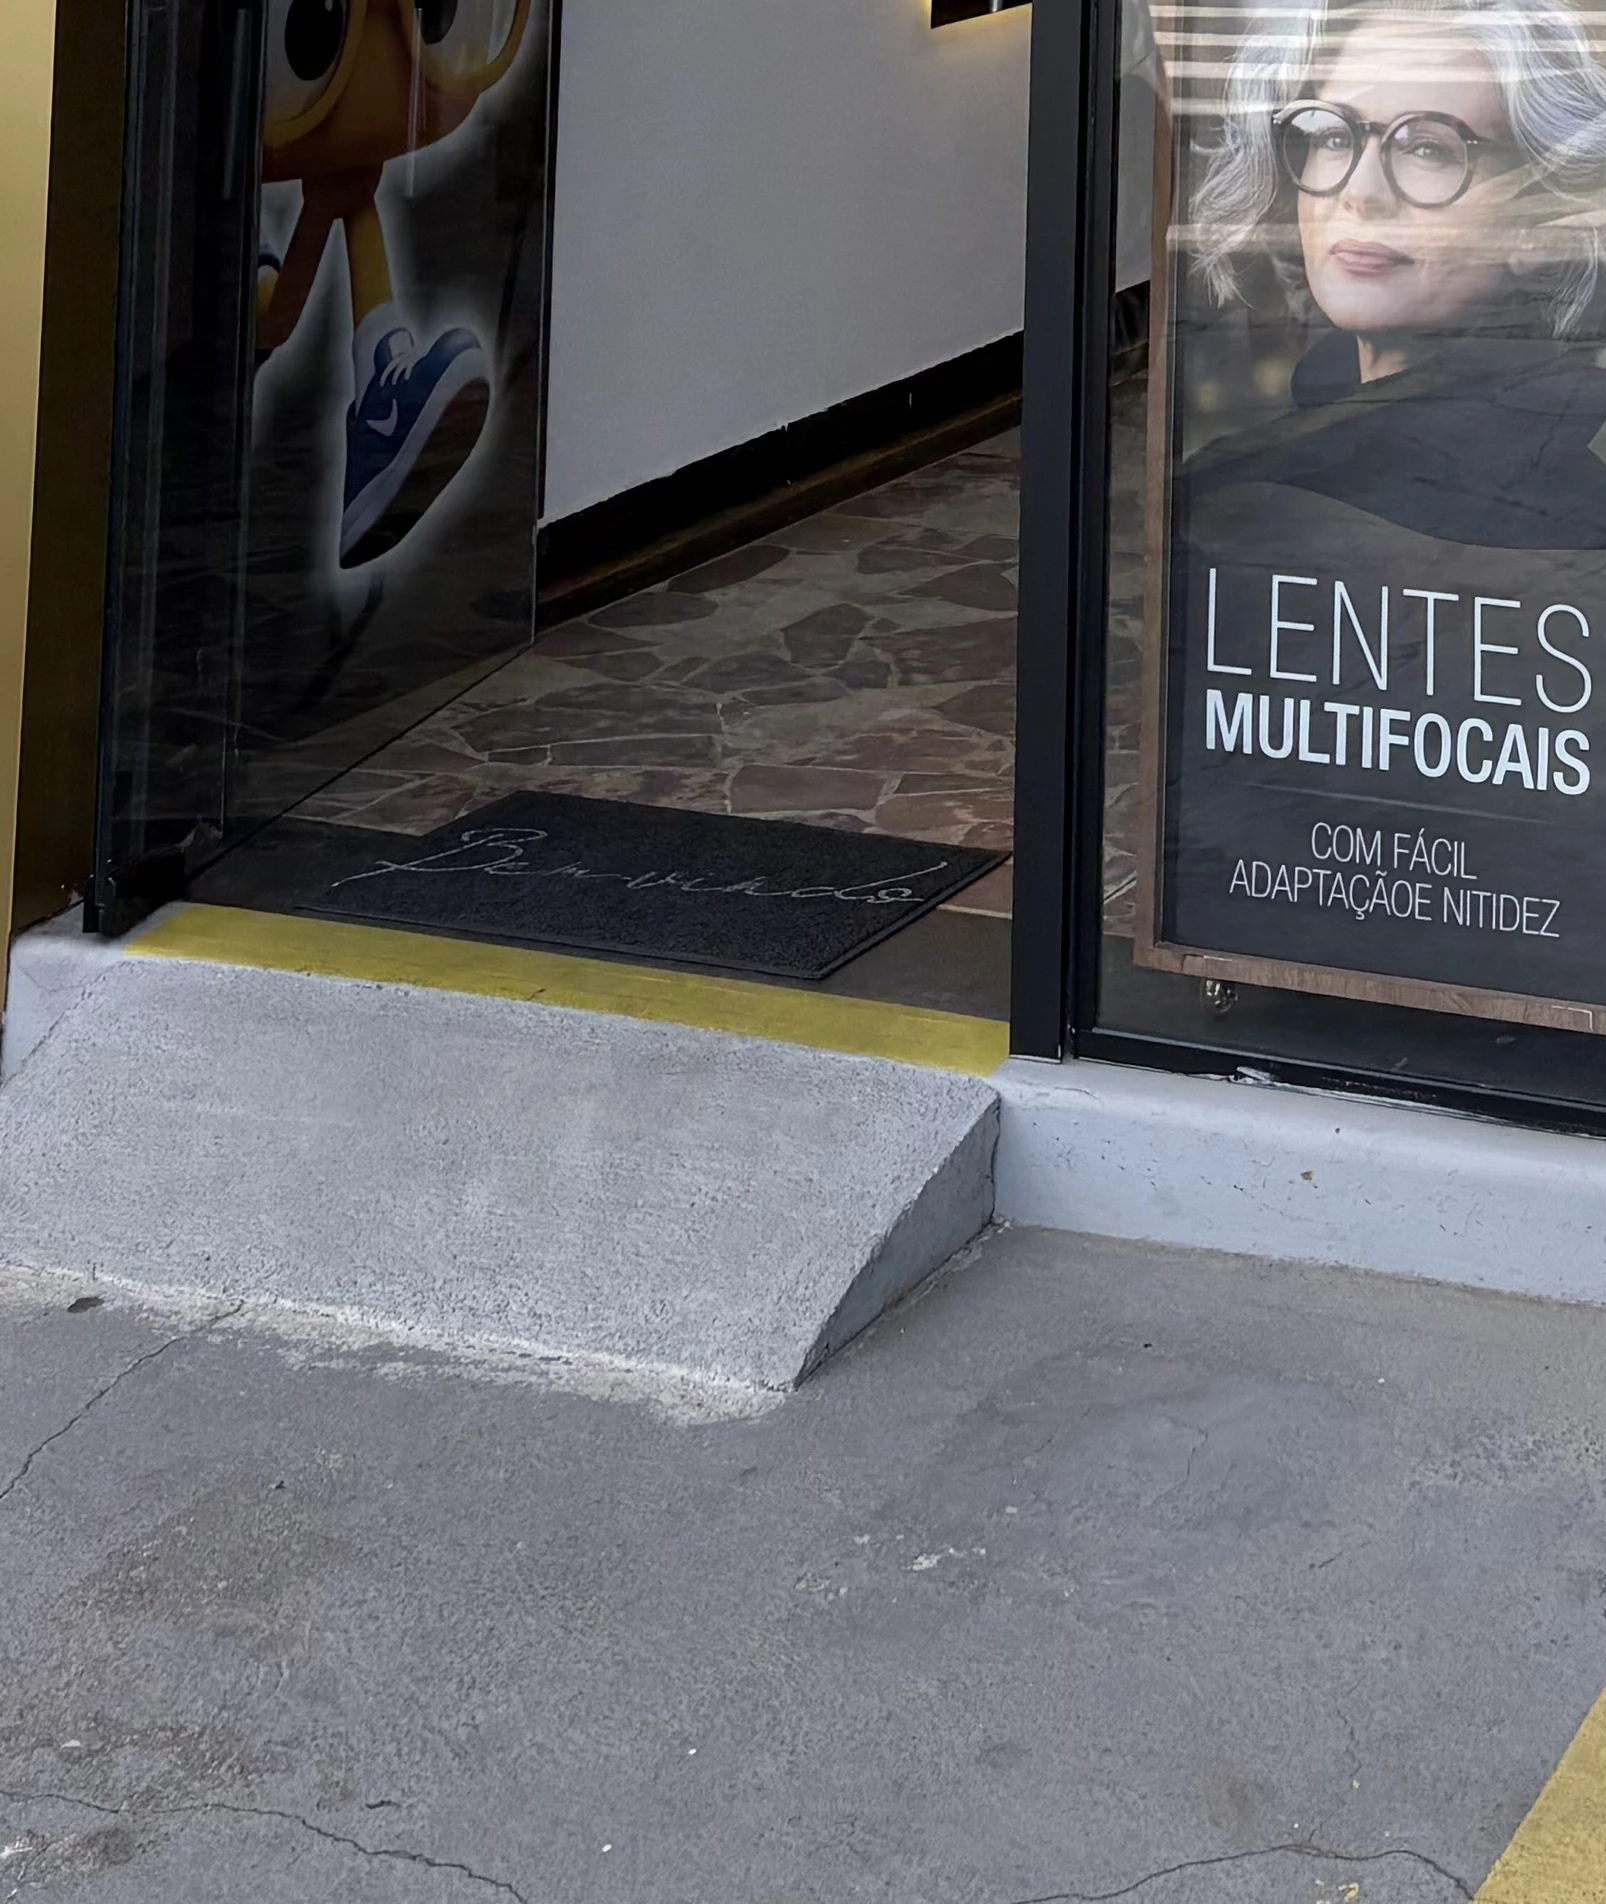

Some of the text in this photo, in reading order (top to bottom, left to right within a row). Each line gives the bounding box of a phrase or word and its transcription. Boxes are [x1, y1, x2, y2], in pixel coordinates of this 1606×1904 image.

[1207, 568, 1593, 714] LENTES
[1206, 688, 1592, 796] MULTIFOCAIS
[1311, 822, 1477, 880] COM FÁCIL
[1444, 887, 1560, 938] NITIDEZ
